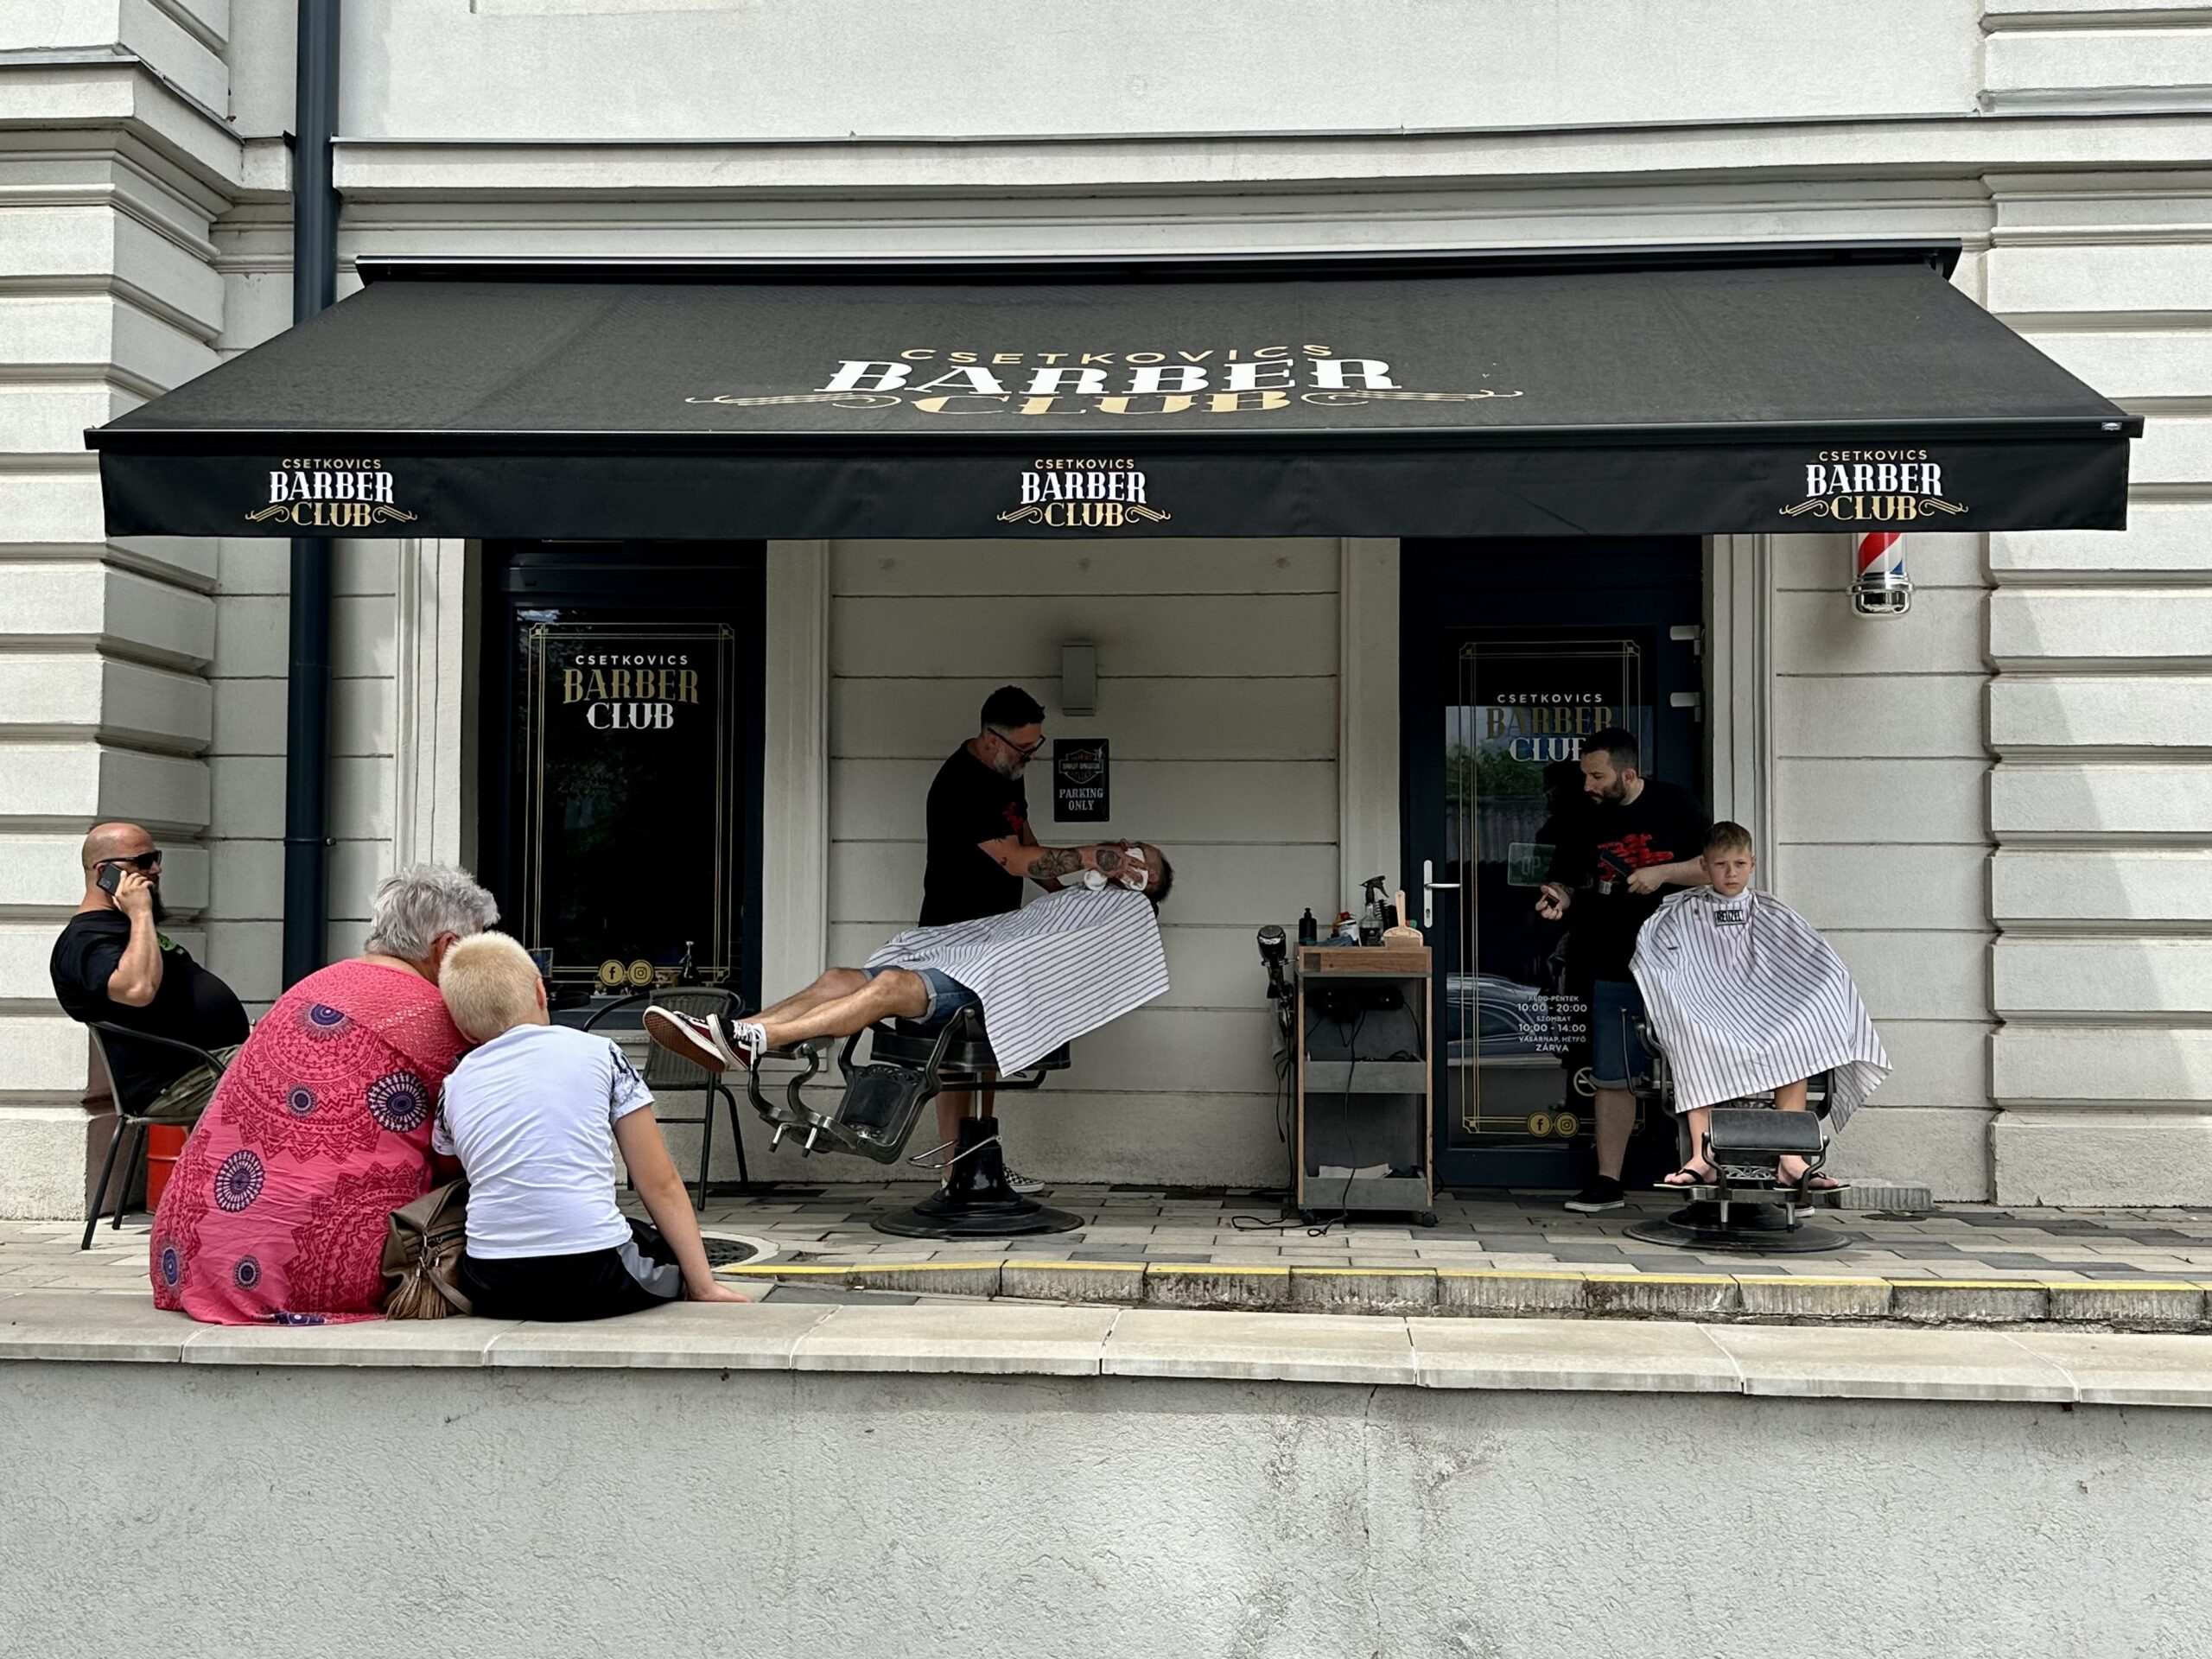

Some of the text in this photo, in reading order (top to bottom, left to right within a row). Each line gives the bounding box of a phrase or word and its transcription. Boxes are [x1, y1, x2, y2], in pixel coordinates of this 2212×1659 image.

[900, 344, 1332, 365] CSETKOVICS
[812, 358, 1402, 395] BARBER
[910, 391, 1291, 415] CLUB
[282, 458, 381, 469] CSETKOVICS
[1034, 459, 1135, 469] CSETKOVICS
[1818, 449, 1928, 461] CSETKOVICS
[269, 471, 394, 504] BARBER
[1020, 472, 1147, 505] BARBER
[1806, 462, 1943, 498] BARBER
[291, 501, 372, 527] CLUB
[1044, 502, 1124, 527] CLUB
[1829, 495, 1917, 521] CLUB
[575, 655, 689, 665] CSETKOVICS
[563, 668, 699, 704] BARBER
[1497, 693, 1603, 703] CSETKOVICS
[586, 702, 674, 729] CLUB
[1486, 706, 1613, 740] BARBER
[1058, 787, 1104, 798] PARKING
[1068, 799, 1095, 810] ONLY
[1517, 1003, 1547, 1012] 10:00
[1556, 1003, 1587, 1013] 20:00
[1518, 1023, 1548, 1033] 10:00
[1558, 1024, 1586, 1033] 14:00
[1535, 1043, 1569, 1052] ZÁRVA
